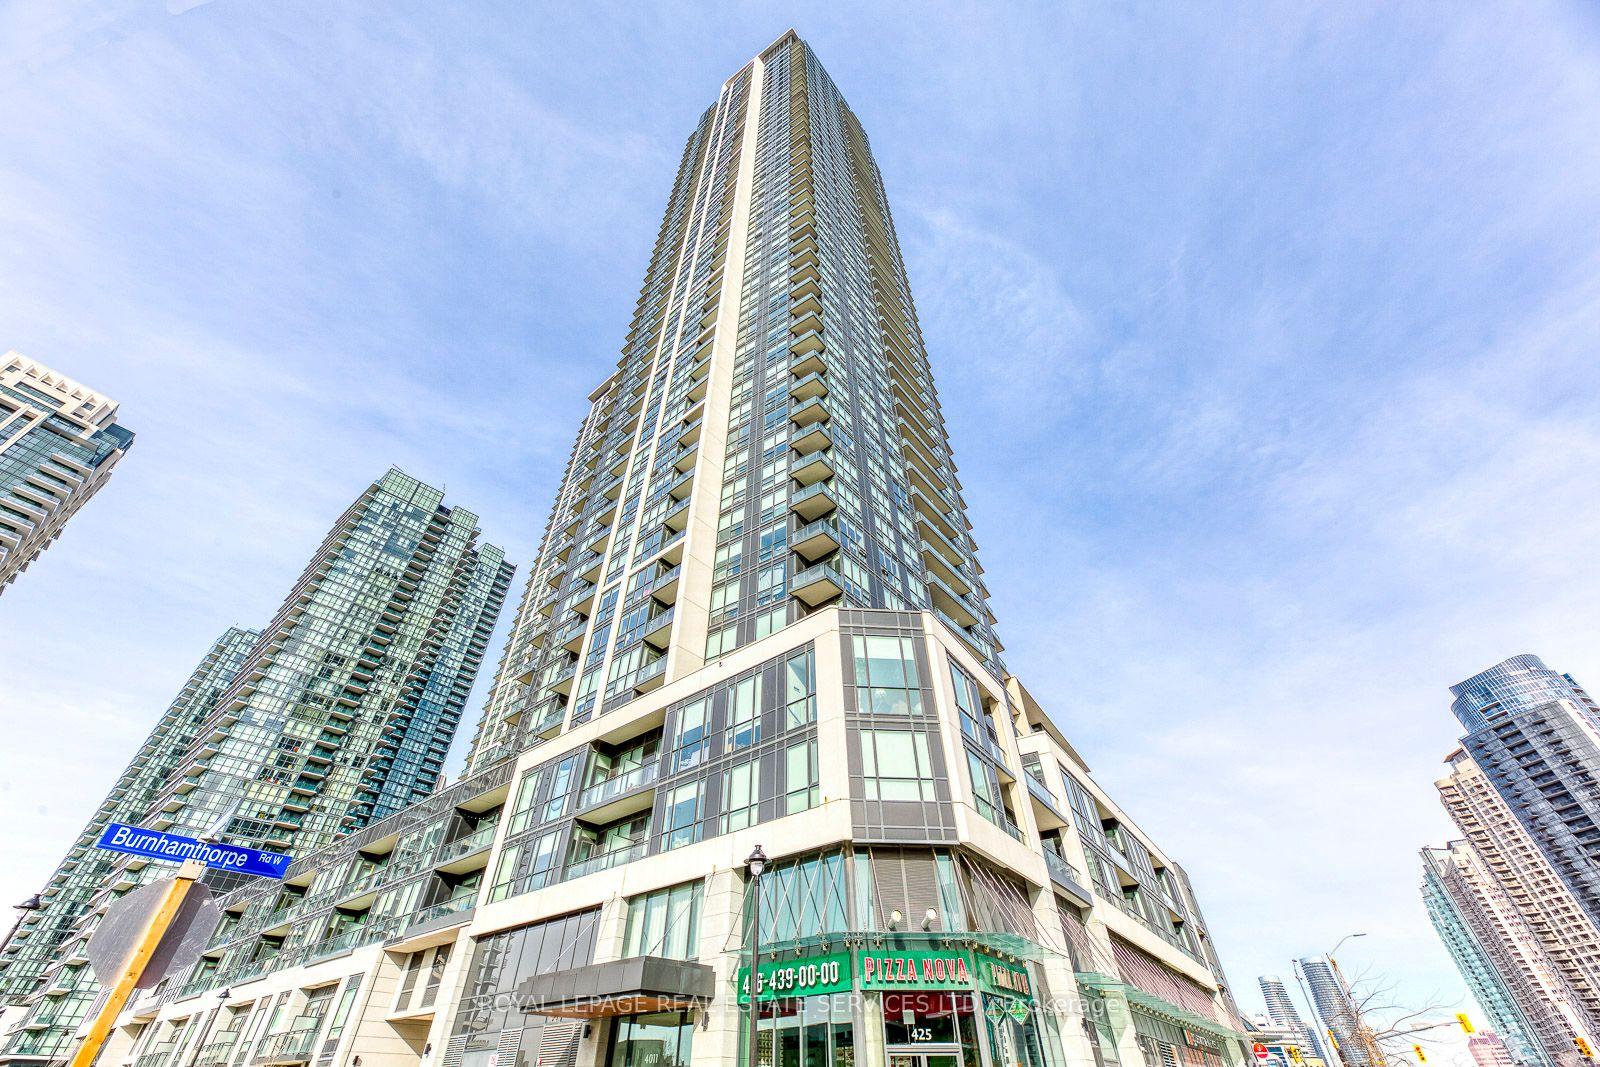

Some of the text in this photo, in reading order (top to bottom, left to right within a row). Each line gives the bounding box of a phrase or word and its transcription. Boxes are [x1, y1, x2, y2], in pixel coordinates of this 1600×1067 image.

[111, 827, 284, 868] Burnhamthorpe Rd W
[742, 961, 839, 994] 46-439-00-00
[864, 957, 969, 983] PIZZA NOVA
[911, 1028, 932, 1041] 425
[644, 1053, 659, 1064] 4011
